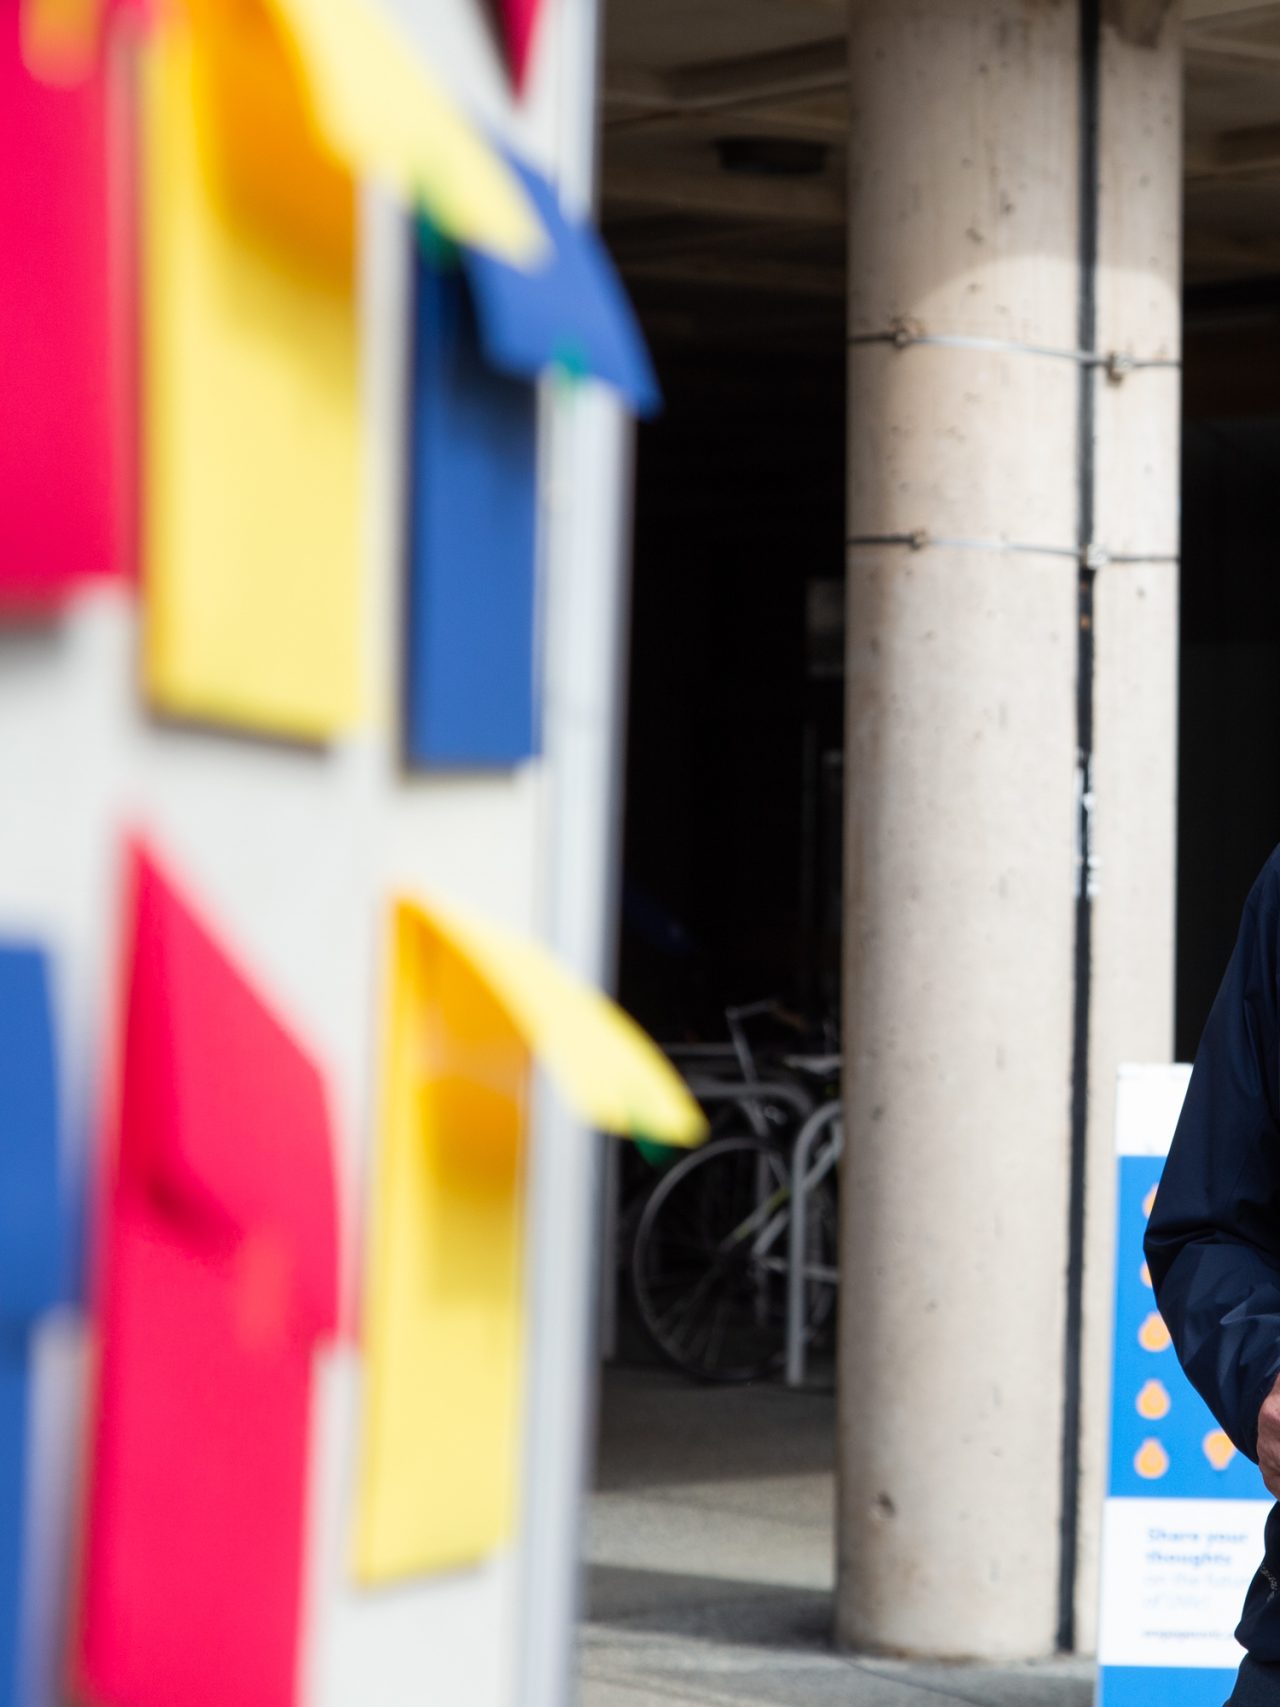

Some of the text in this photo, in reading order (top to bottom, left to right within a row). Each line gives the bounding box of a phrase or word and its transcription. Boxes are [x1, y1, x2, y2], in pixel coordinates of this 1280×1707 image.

[1148, 1527, 1249, 1548] Share your
[1145, 1548, 1232, 1568] thoughts
